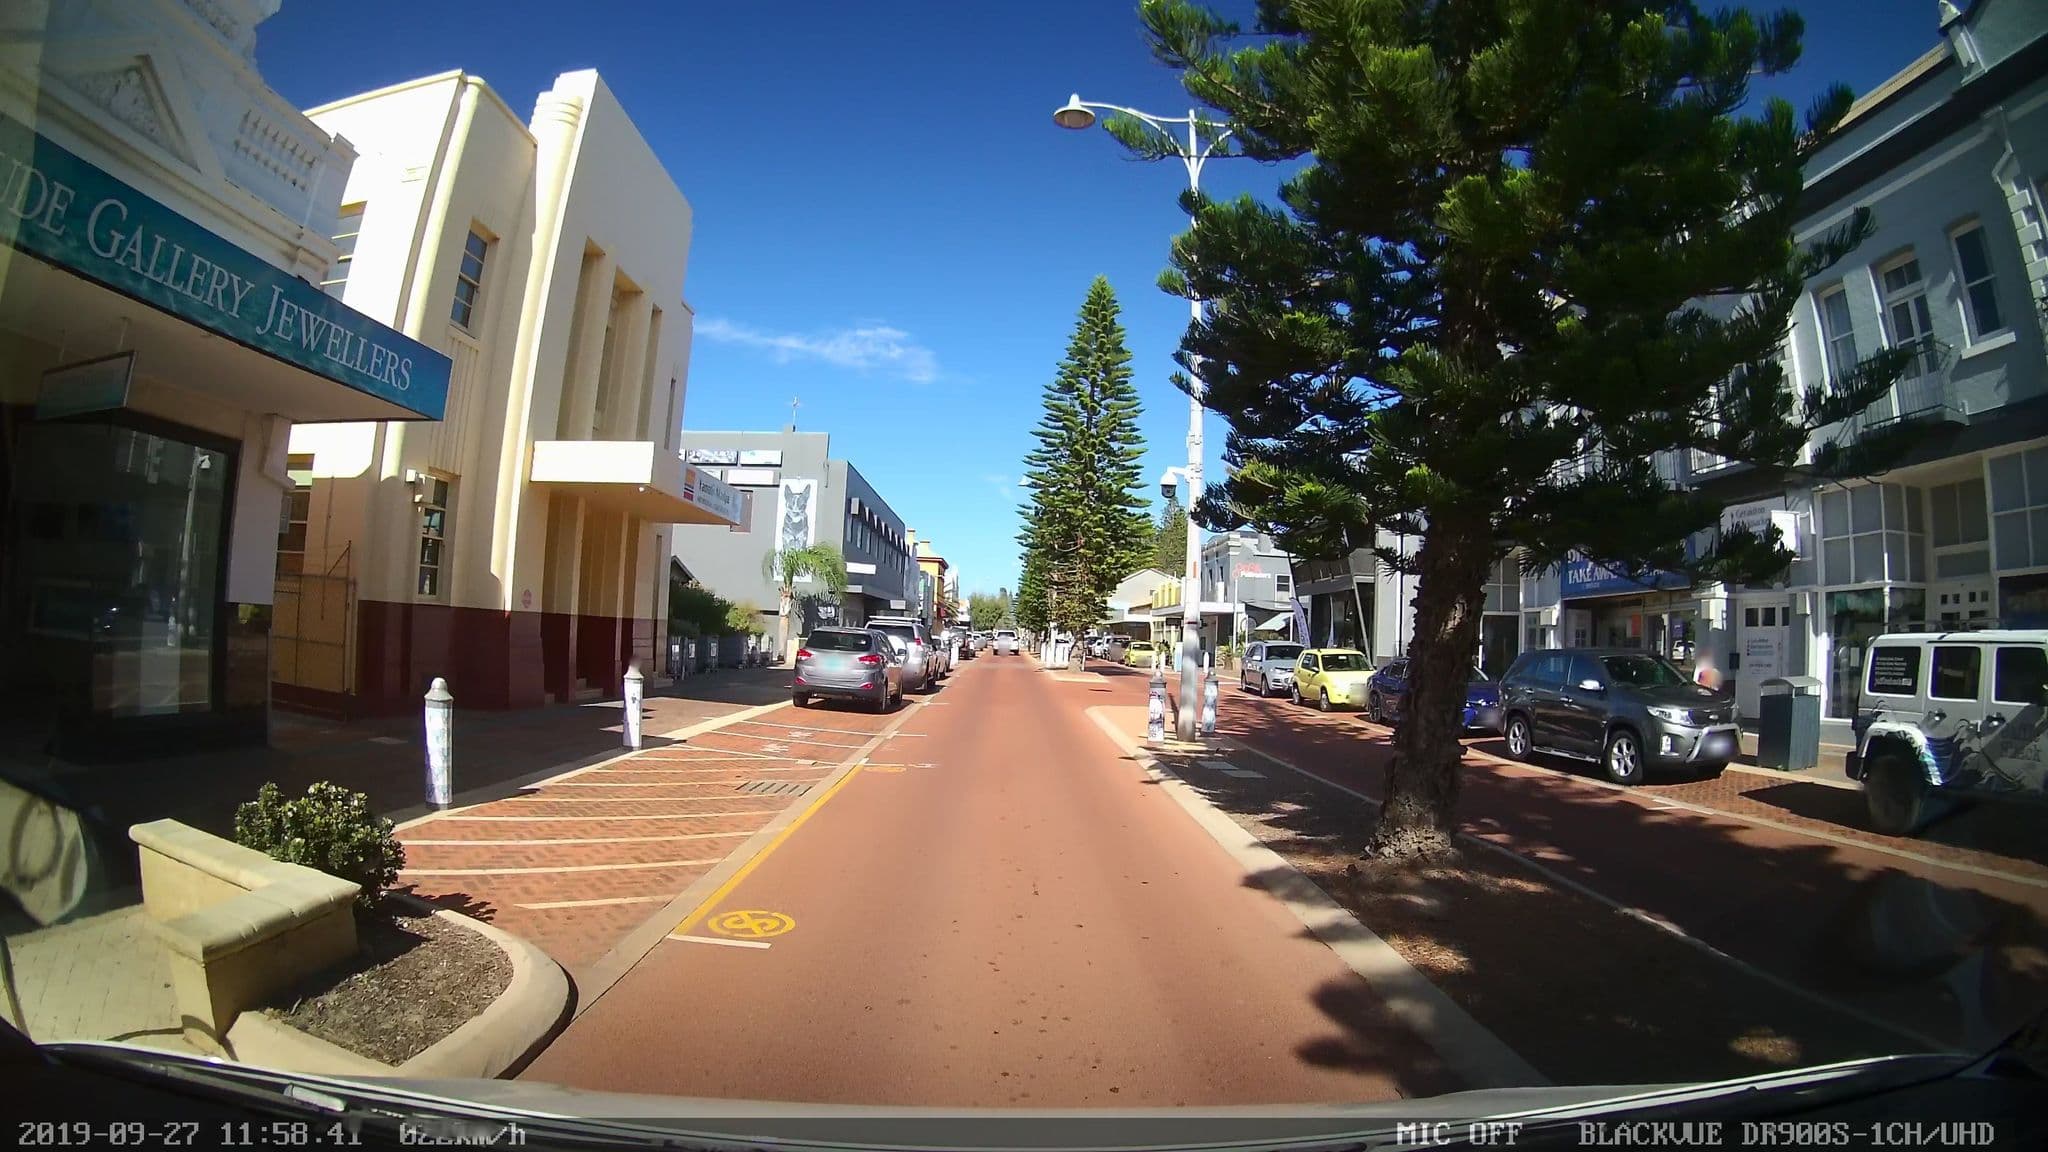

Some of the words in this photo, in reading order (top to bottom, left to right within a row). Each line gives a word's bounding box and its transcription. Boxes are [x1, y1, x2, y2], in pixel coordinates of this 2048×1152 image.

[87, 198, 255, 319] GALLERY
[256, 284, 413, 391] JEWELLERS
[1568, 568, 1592, 585] TAKE
